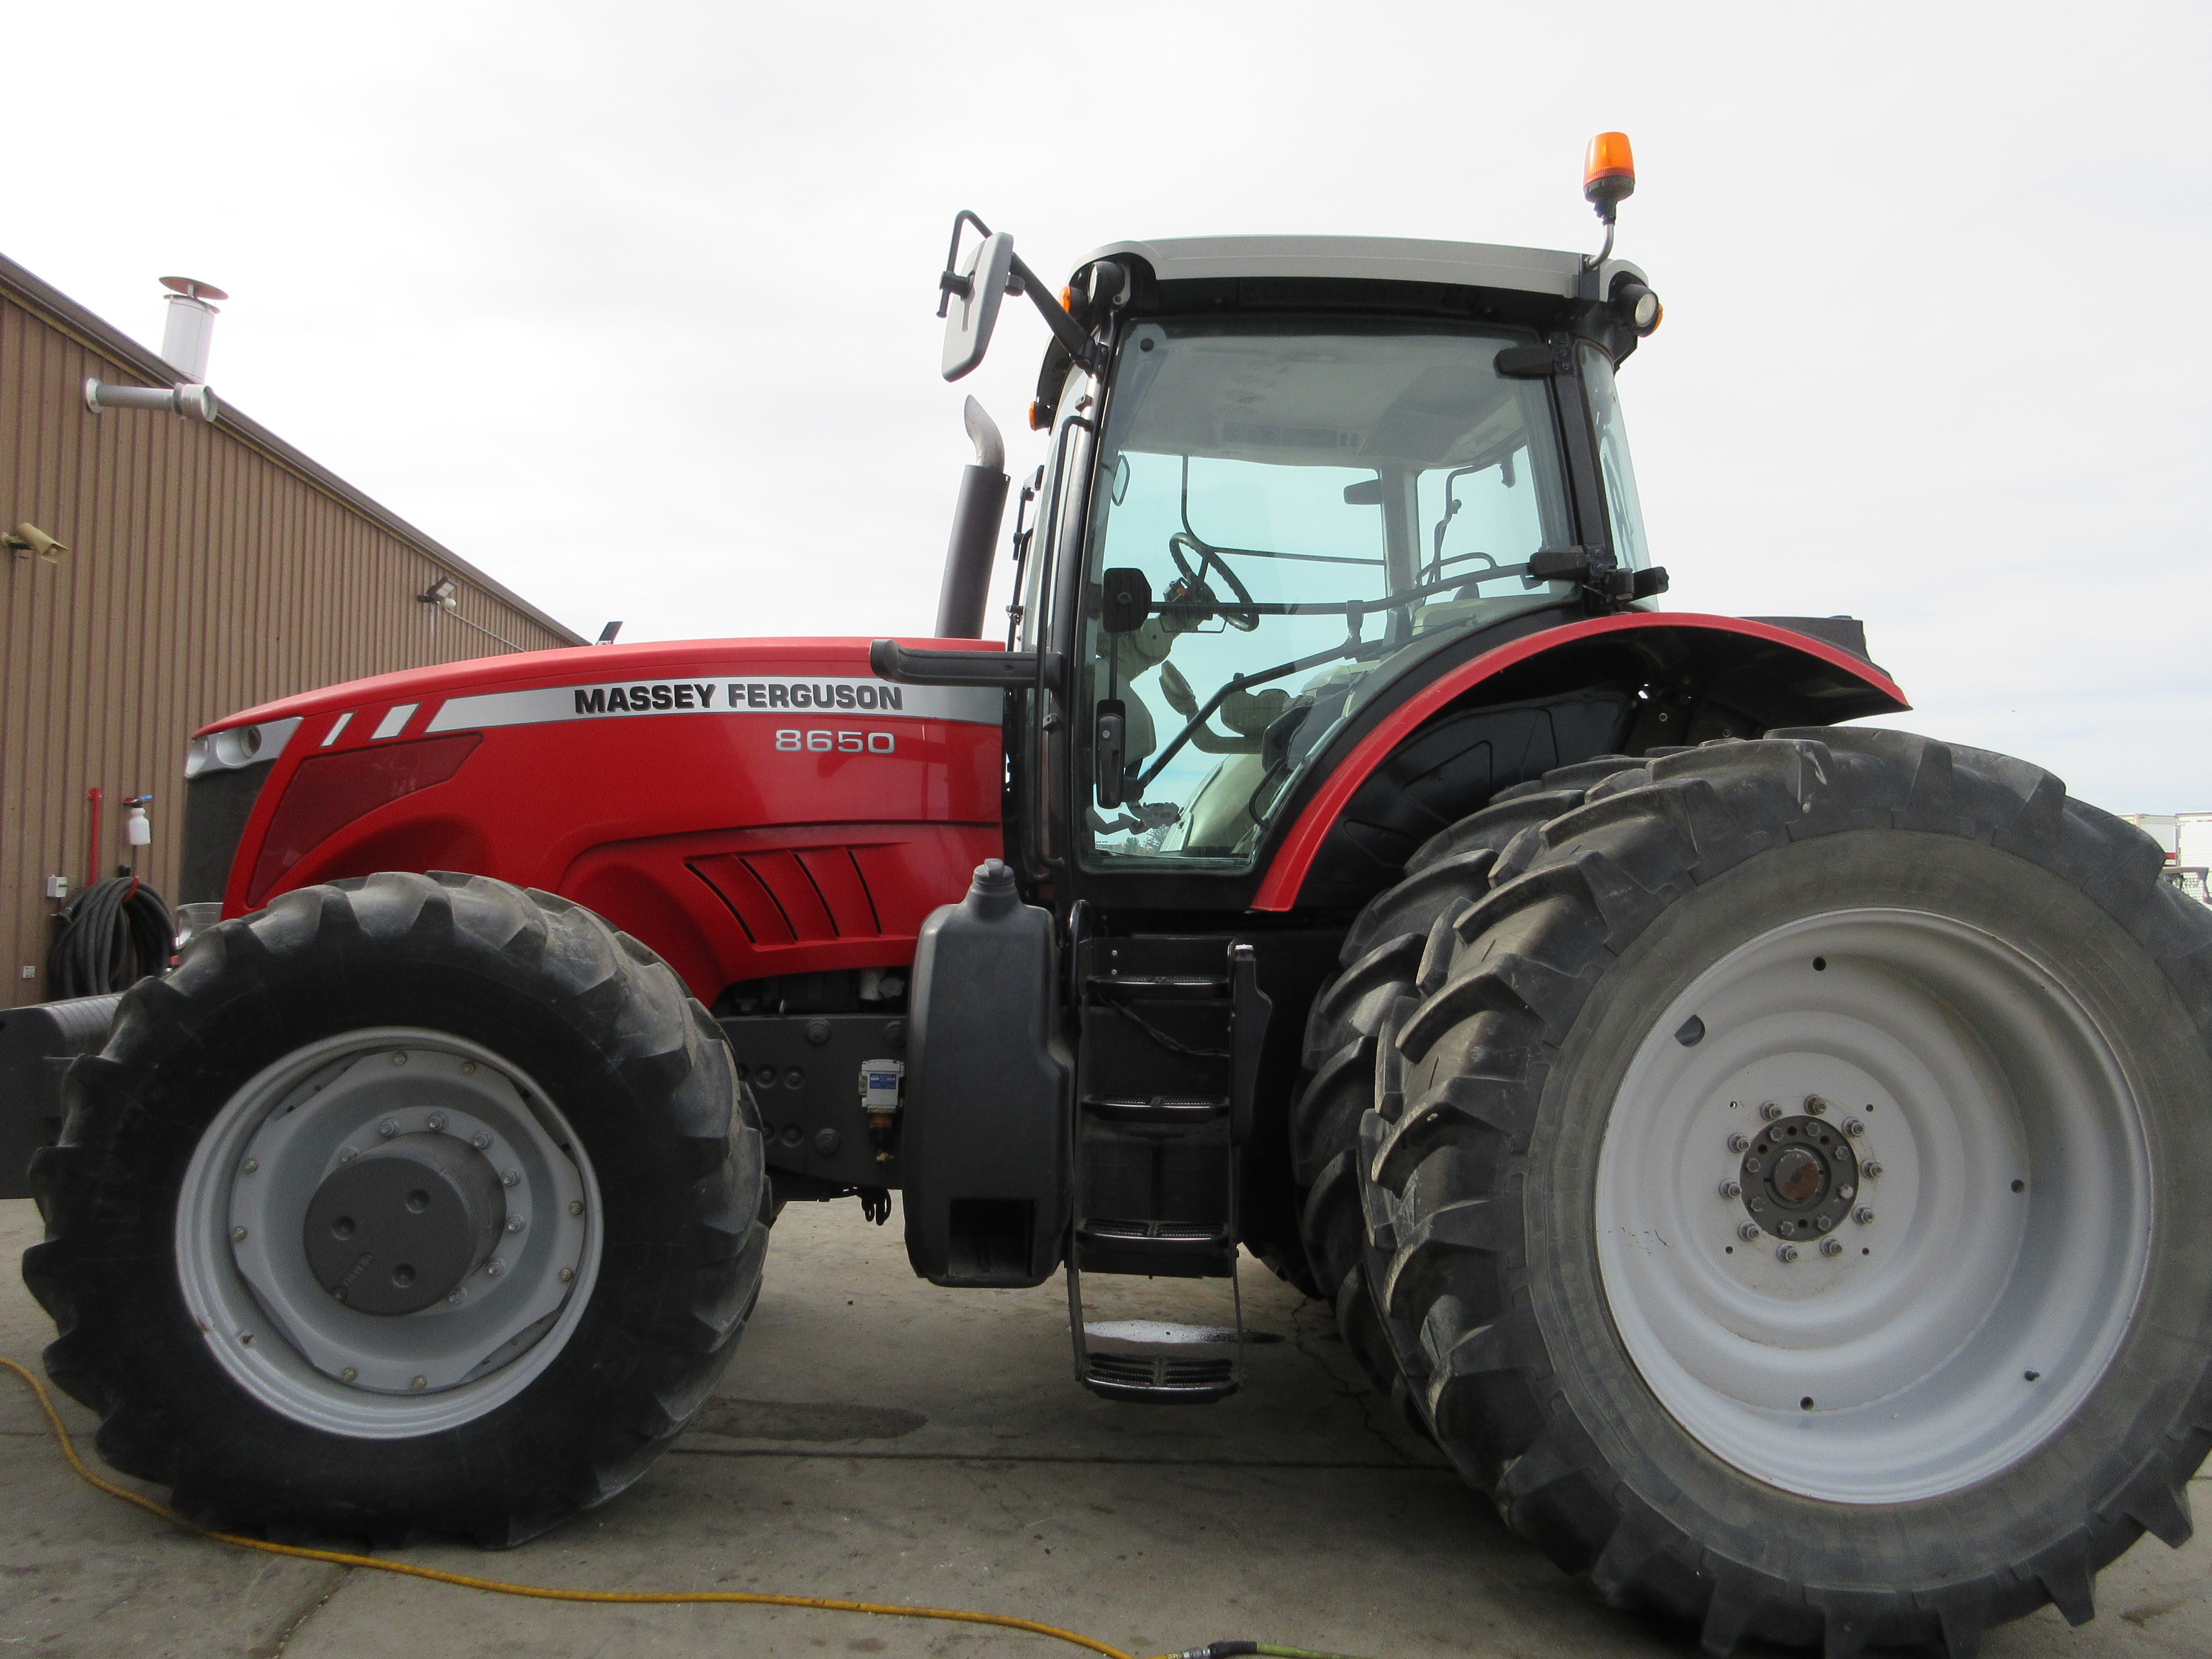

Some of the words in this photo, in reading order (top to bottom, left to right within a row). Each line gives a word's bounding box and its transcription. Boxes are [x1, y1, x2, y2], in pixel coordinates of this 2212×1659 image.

[574, 684, 718, 714] MASSEY
[728, 683, 904, 710] FERGUSON
[775, 729, 895, 754] 8650
